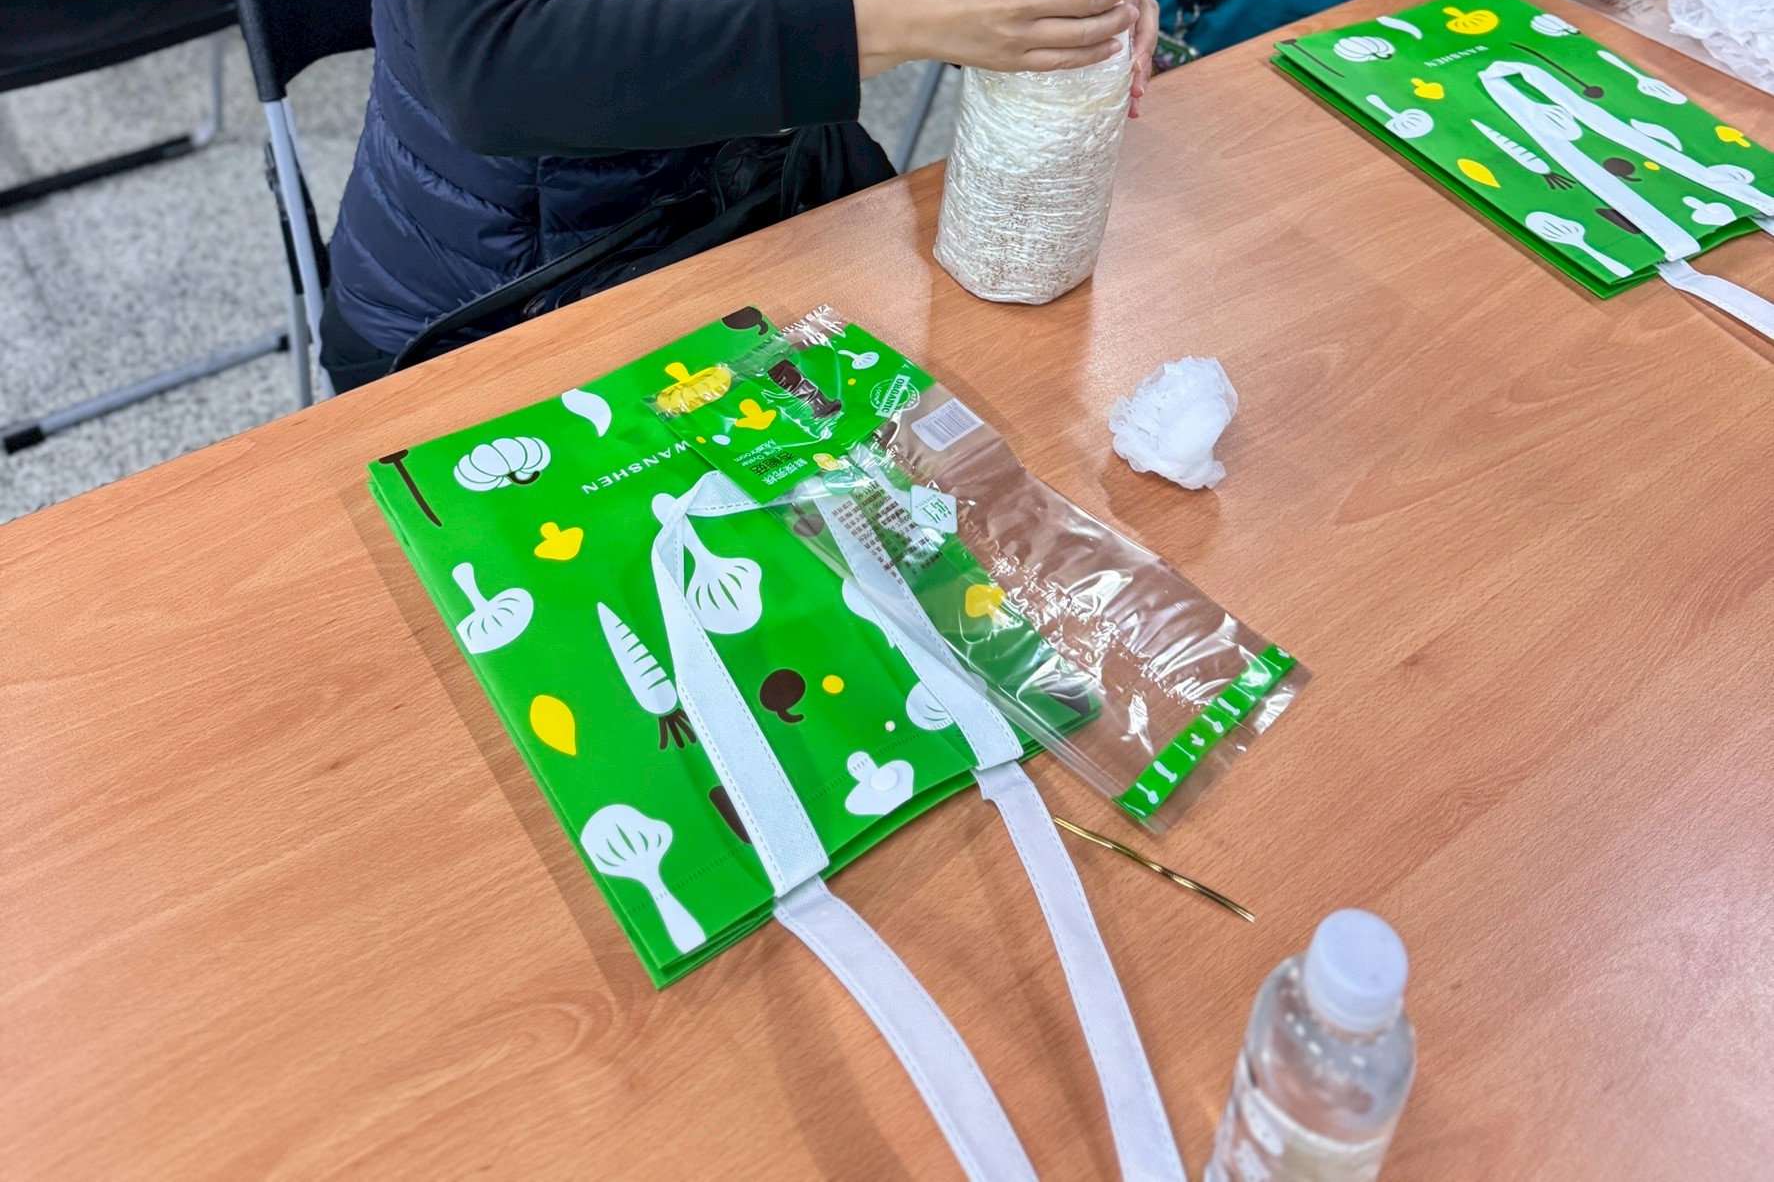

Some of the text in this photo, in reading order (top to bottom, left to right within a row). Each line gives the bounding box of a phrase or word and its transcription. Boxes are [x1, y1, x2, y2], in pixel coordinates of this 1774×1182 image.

[881, 378, 905, 414] ORGANIC
[733, 439, 777, 462] Mushroom
[750, 452, 796, 476] 杏鮑菇
[581, 440, 692, 494] WANSHEN
